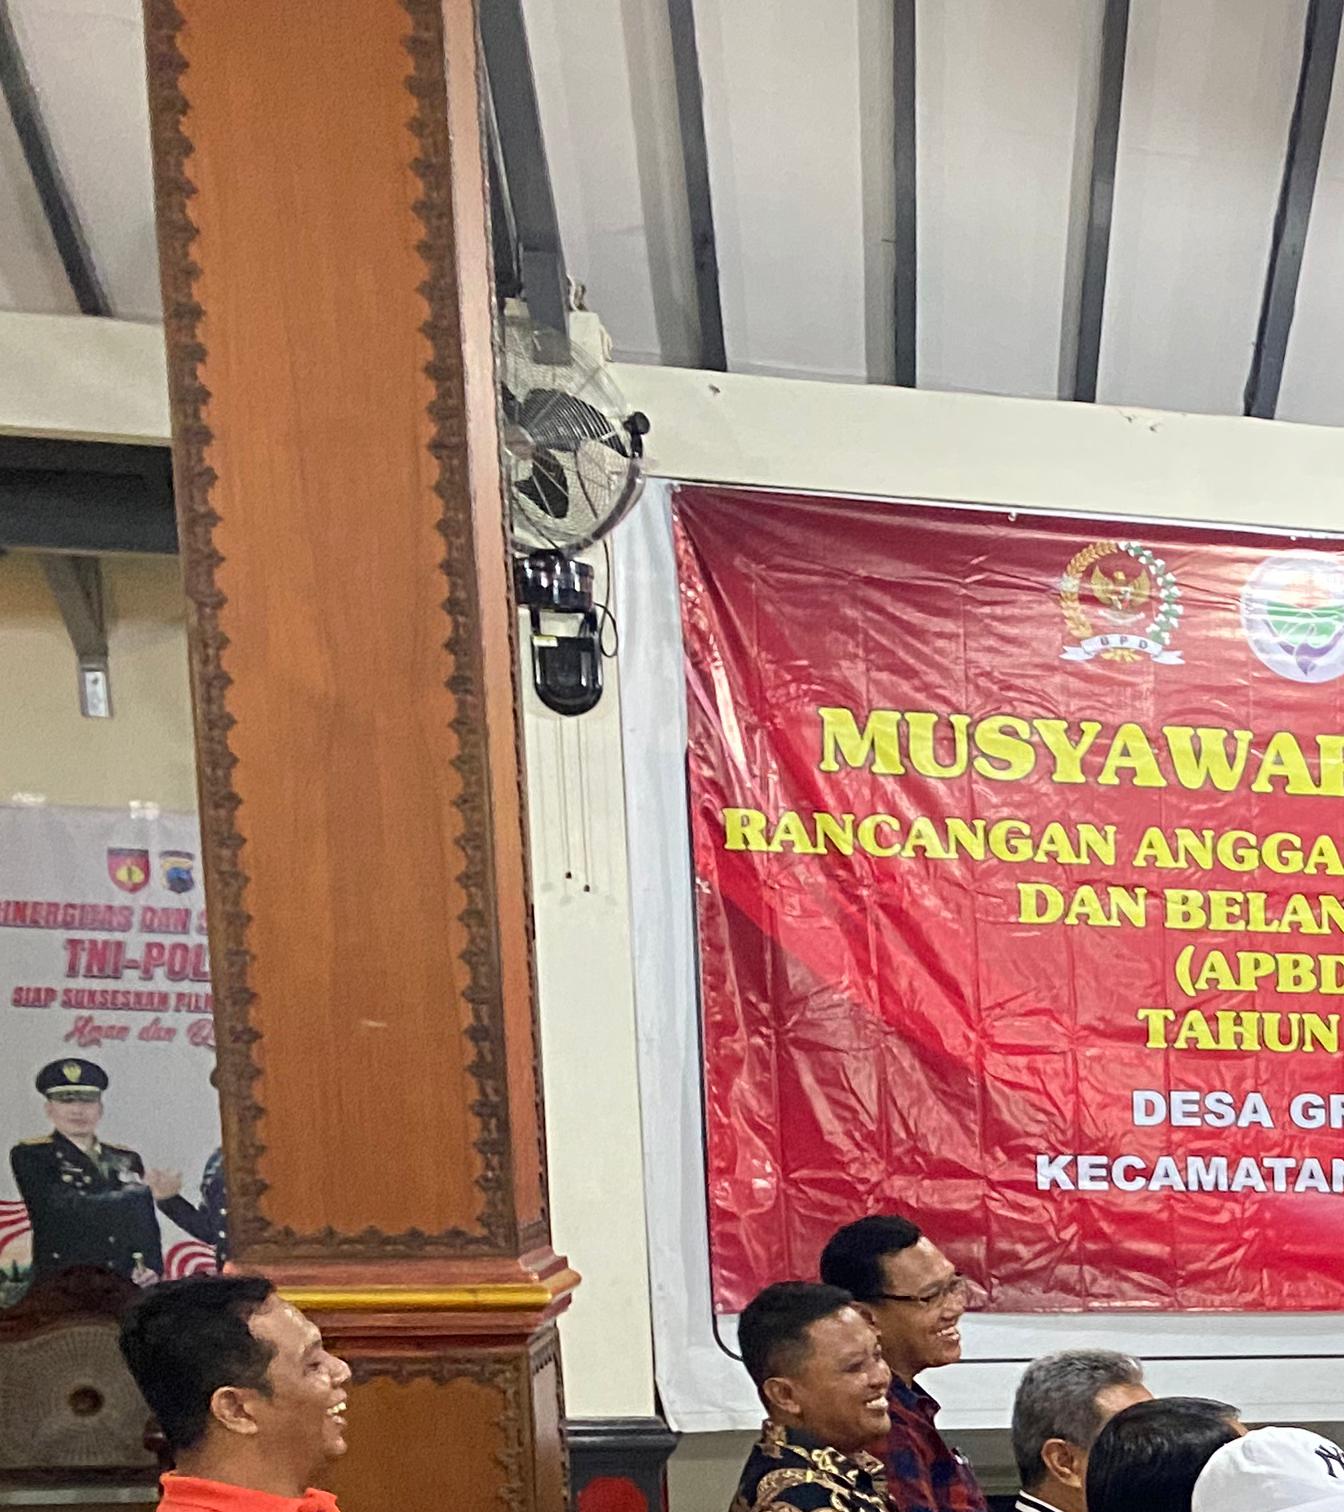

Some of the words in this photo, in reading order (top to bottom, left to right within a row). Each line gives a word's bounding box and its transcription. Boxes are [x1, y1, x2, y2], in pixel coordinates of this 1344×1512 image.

[726, 808, 1113, 865] RANCANGAN
[1019, 884, 1145, 926] DAN
[64, 938, 211, 983] TNI-POL
[1143, 1010, 1337, 1053] TAHUN
[1132, 1090, 1275, 1129] DESA
